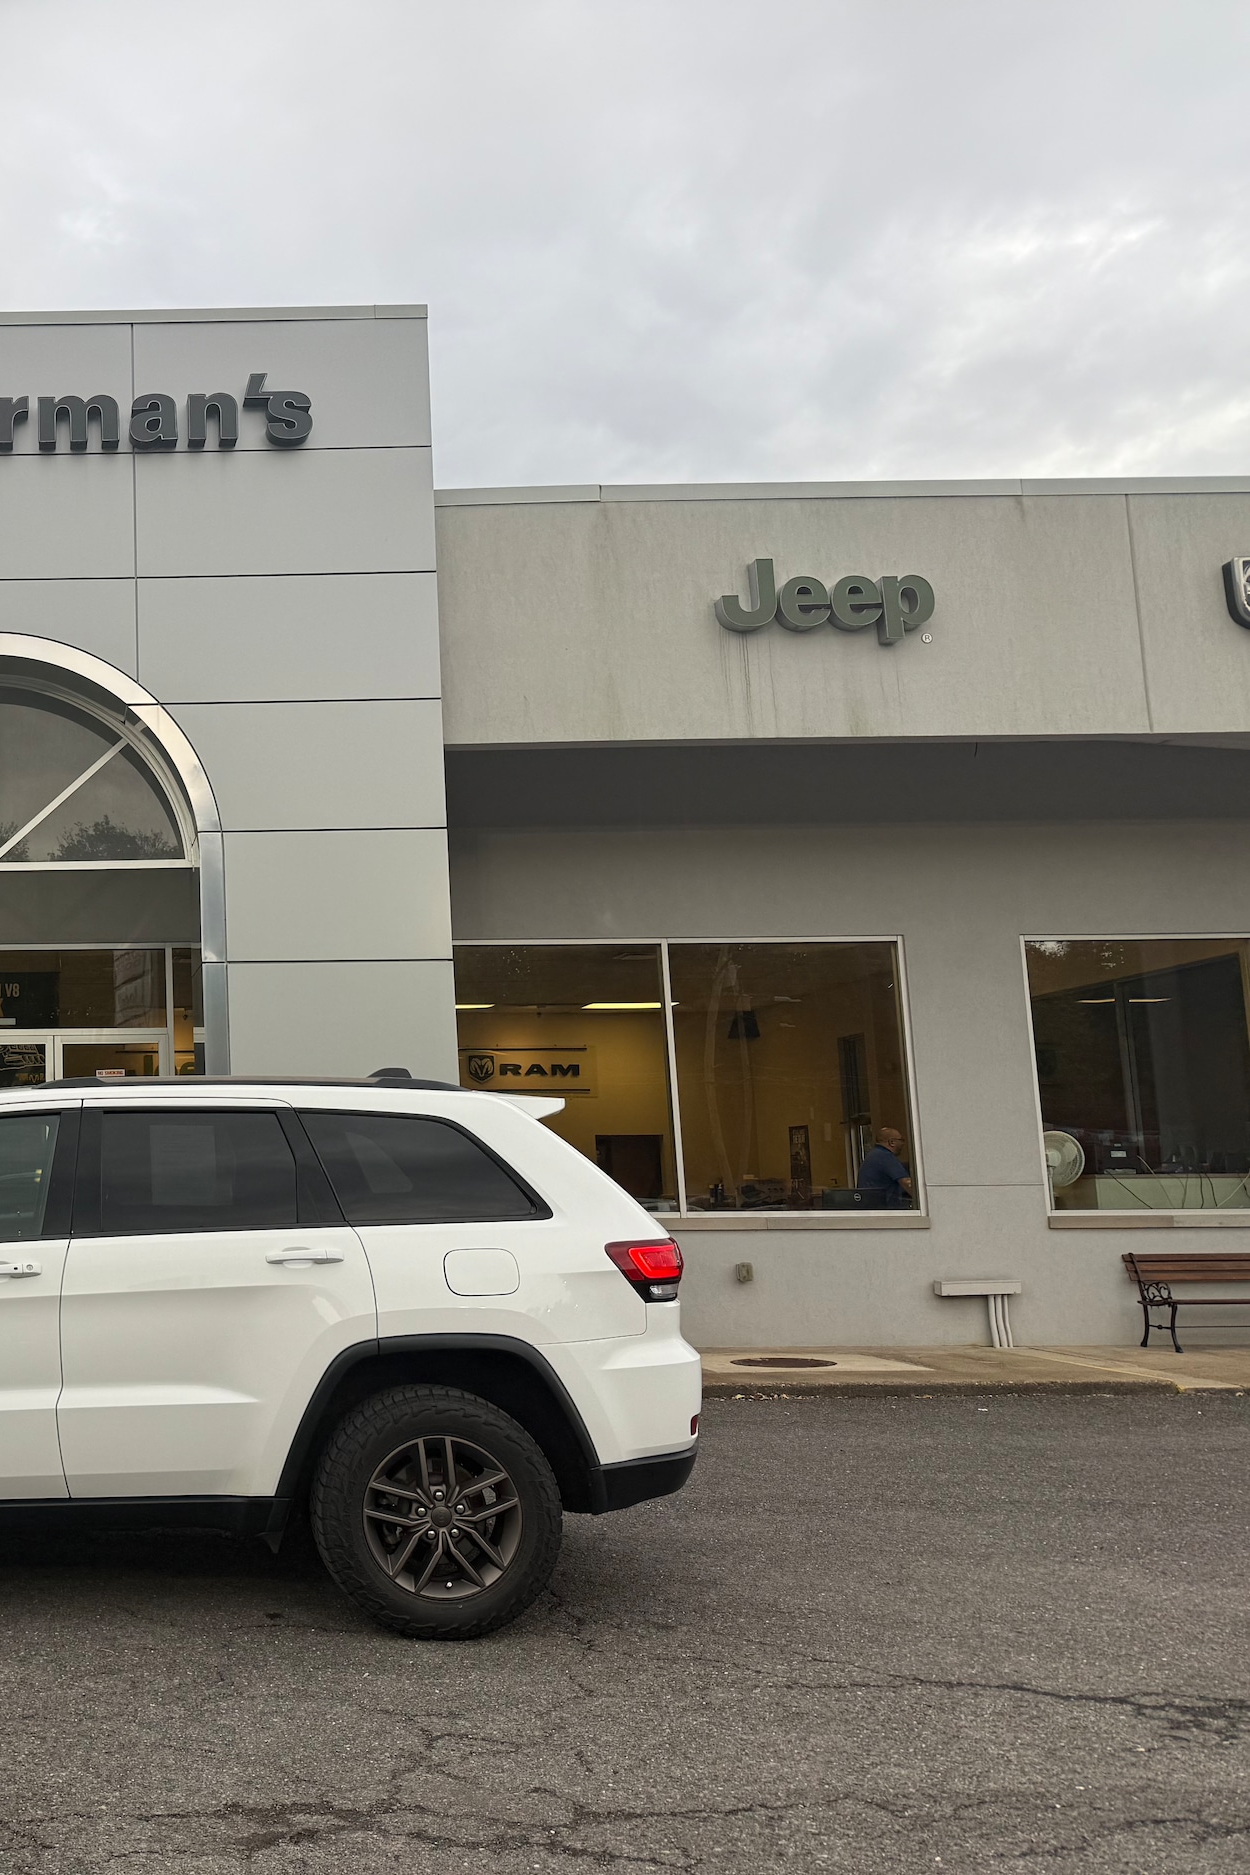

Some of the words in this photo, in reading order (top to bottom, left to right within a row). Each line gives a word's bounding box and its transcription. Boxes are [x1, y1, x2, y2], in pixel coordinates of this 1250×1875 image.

[714, 558, 935, 646] Jeep
[5, 983, 20, 998] V8
[499, 1063, 580, 1077] RAM
